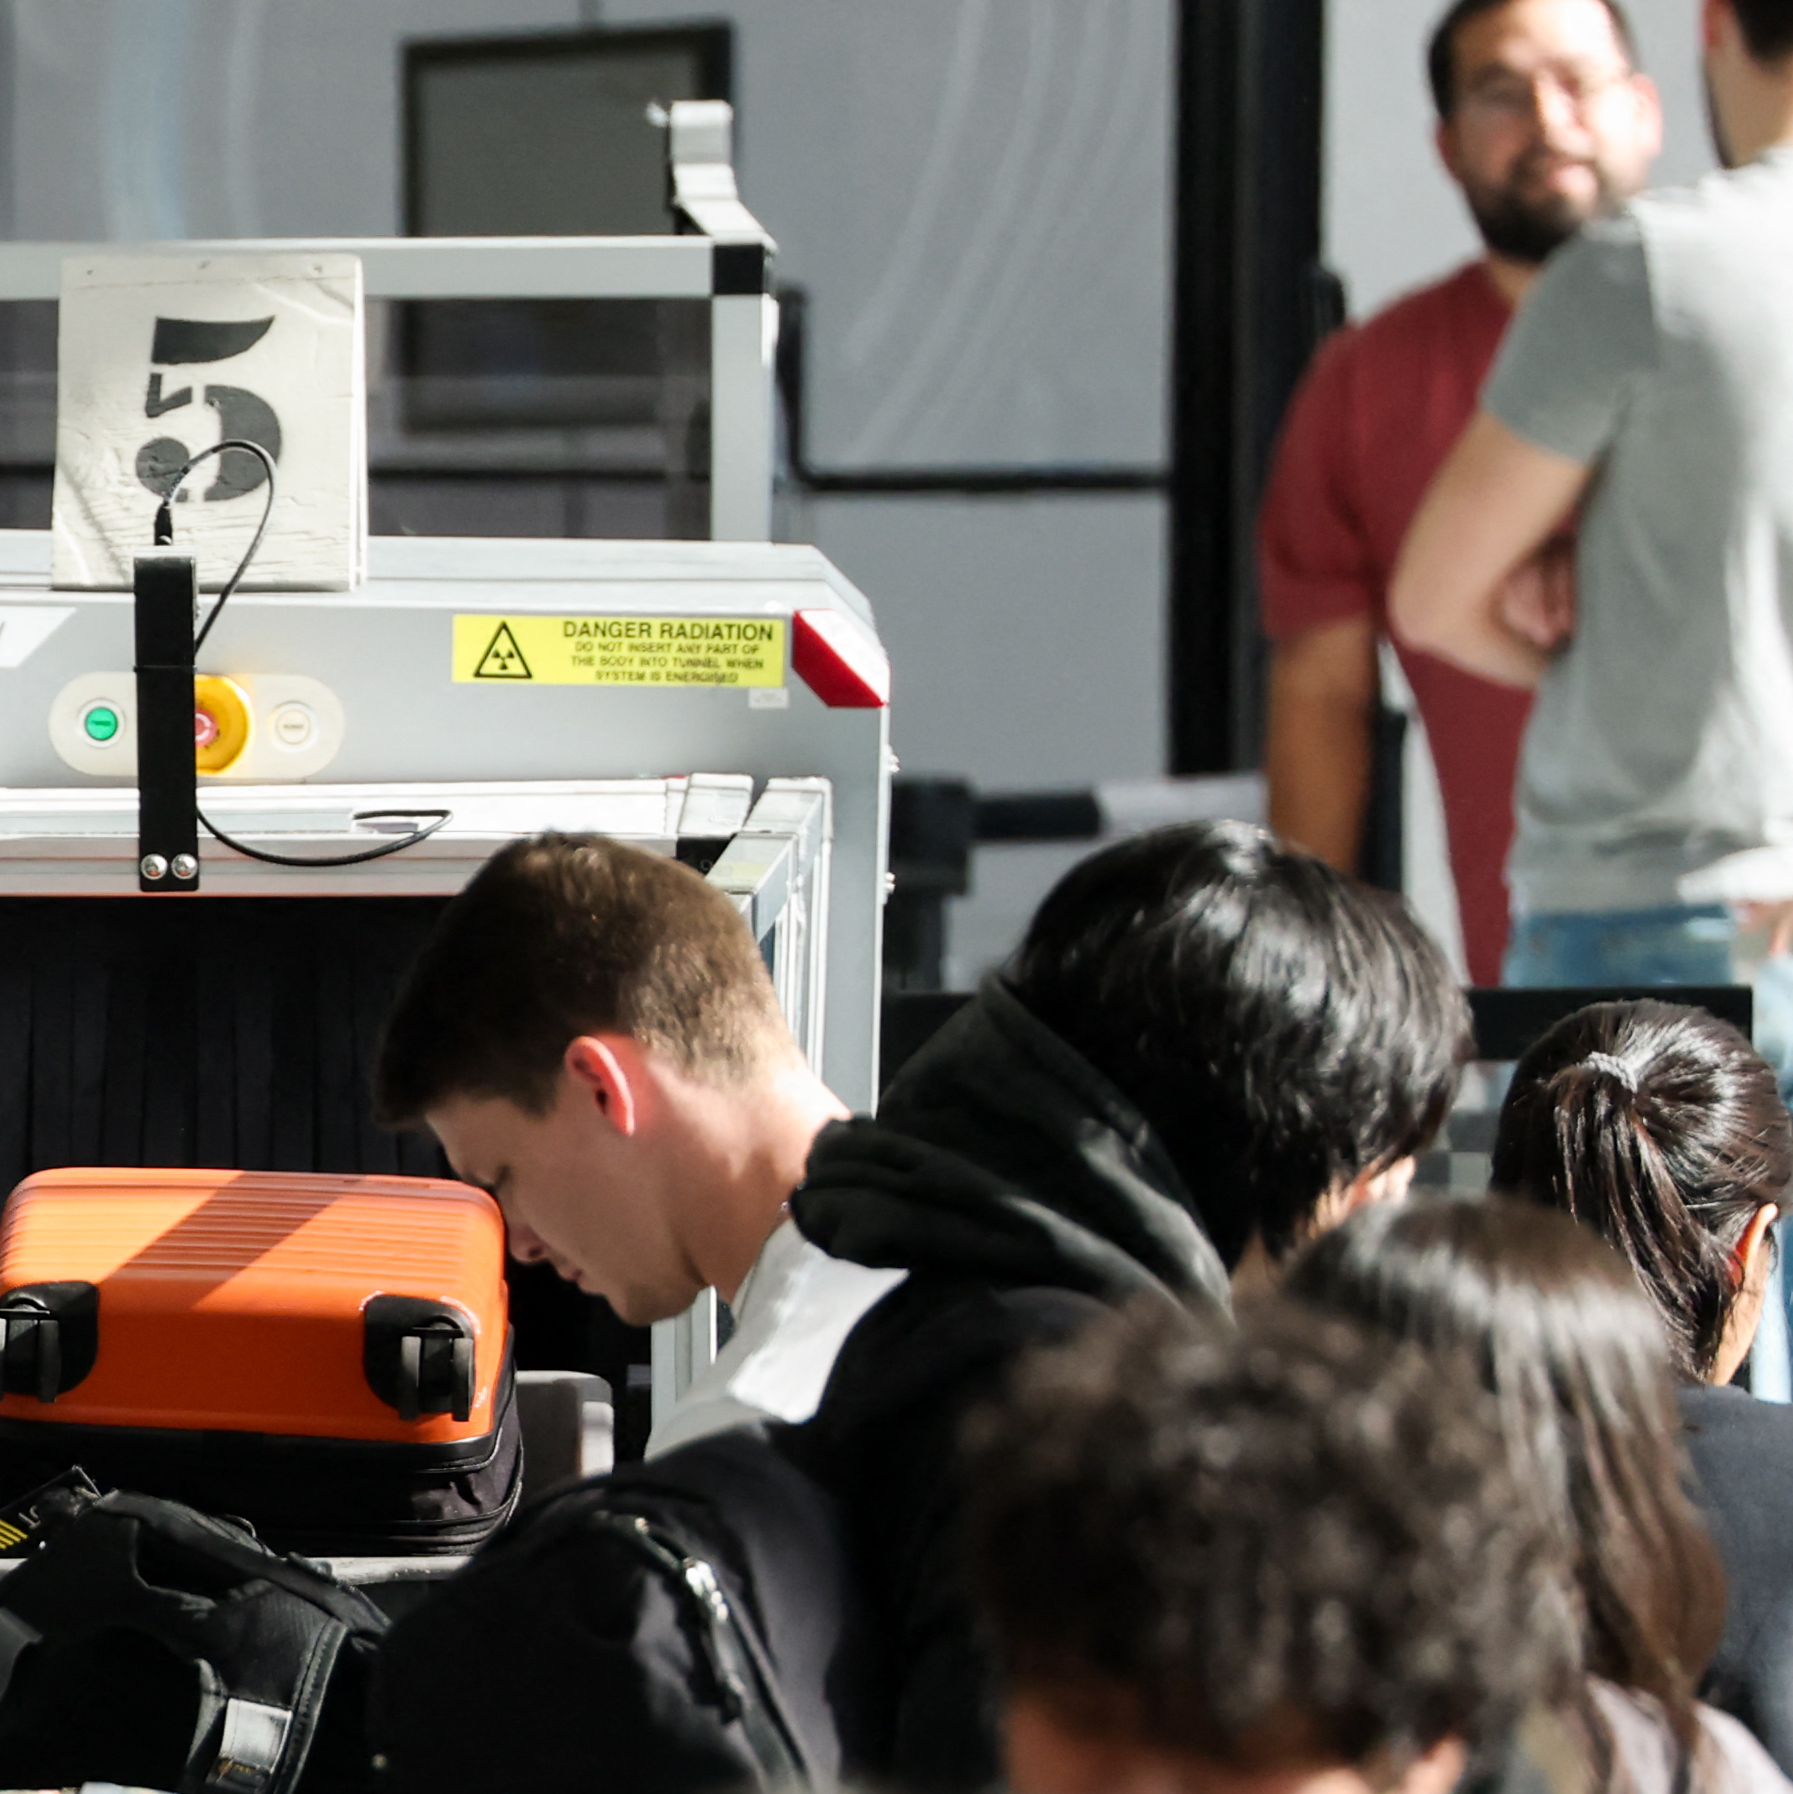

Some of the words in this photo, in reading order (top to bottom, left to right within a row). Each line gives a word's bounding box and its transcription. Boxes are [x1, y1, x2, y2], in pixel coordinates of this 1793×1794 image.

[136, 315, 282, 503] 5
[563, 620, 652, 638] DANGER
[659, 621, 773, 641] RADIATION
[575, 641, 594, 652] DO
[598, 641, 623, 653] NOT
[627, 642, 672, 653] INSERT
[676, 643, 701, 653] ANY
[705, 643, 738, 654] PART
[741, 644, 760, 655] OF
[571, 655, 595, 667] THE
[599, 655, 634, 667] BODY
[640, 656, 668, 668] INTO
[595, 670, 646, 681] SYSTEM
[650, 671, 662, 682] IS
